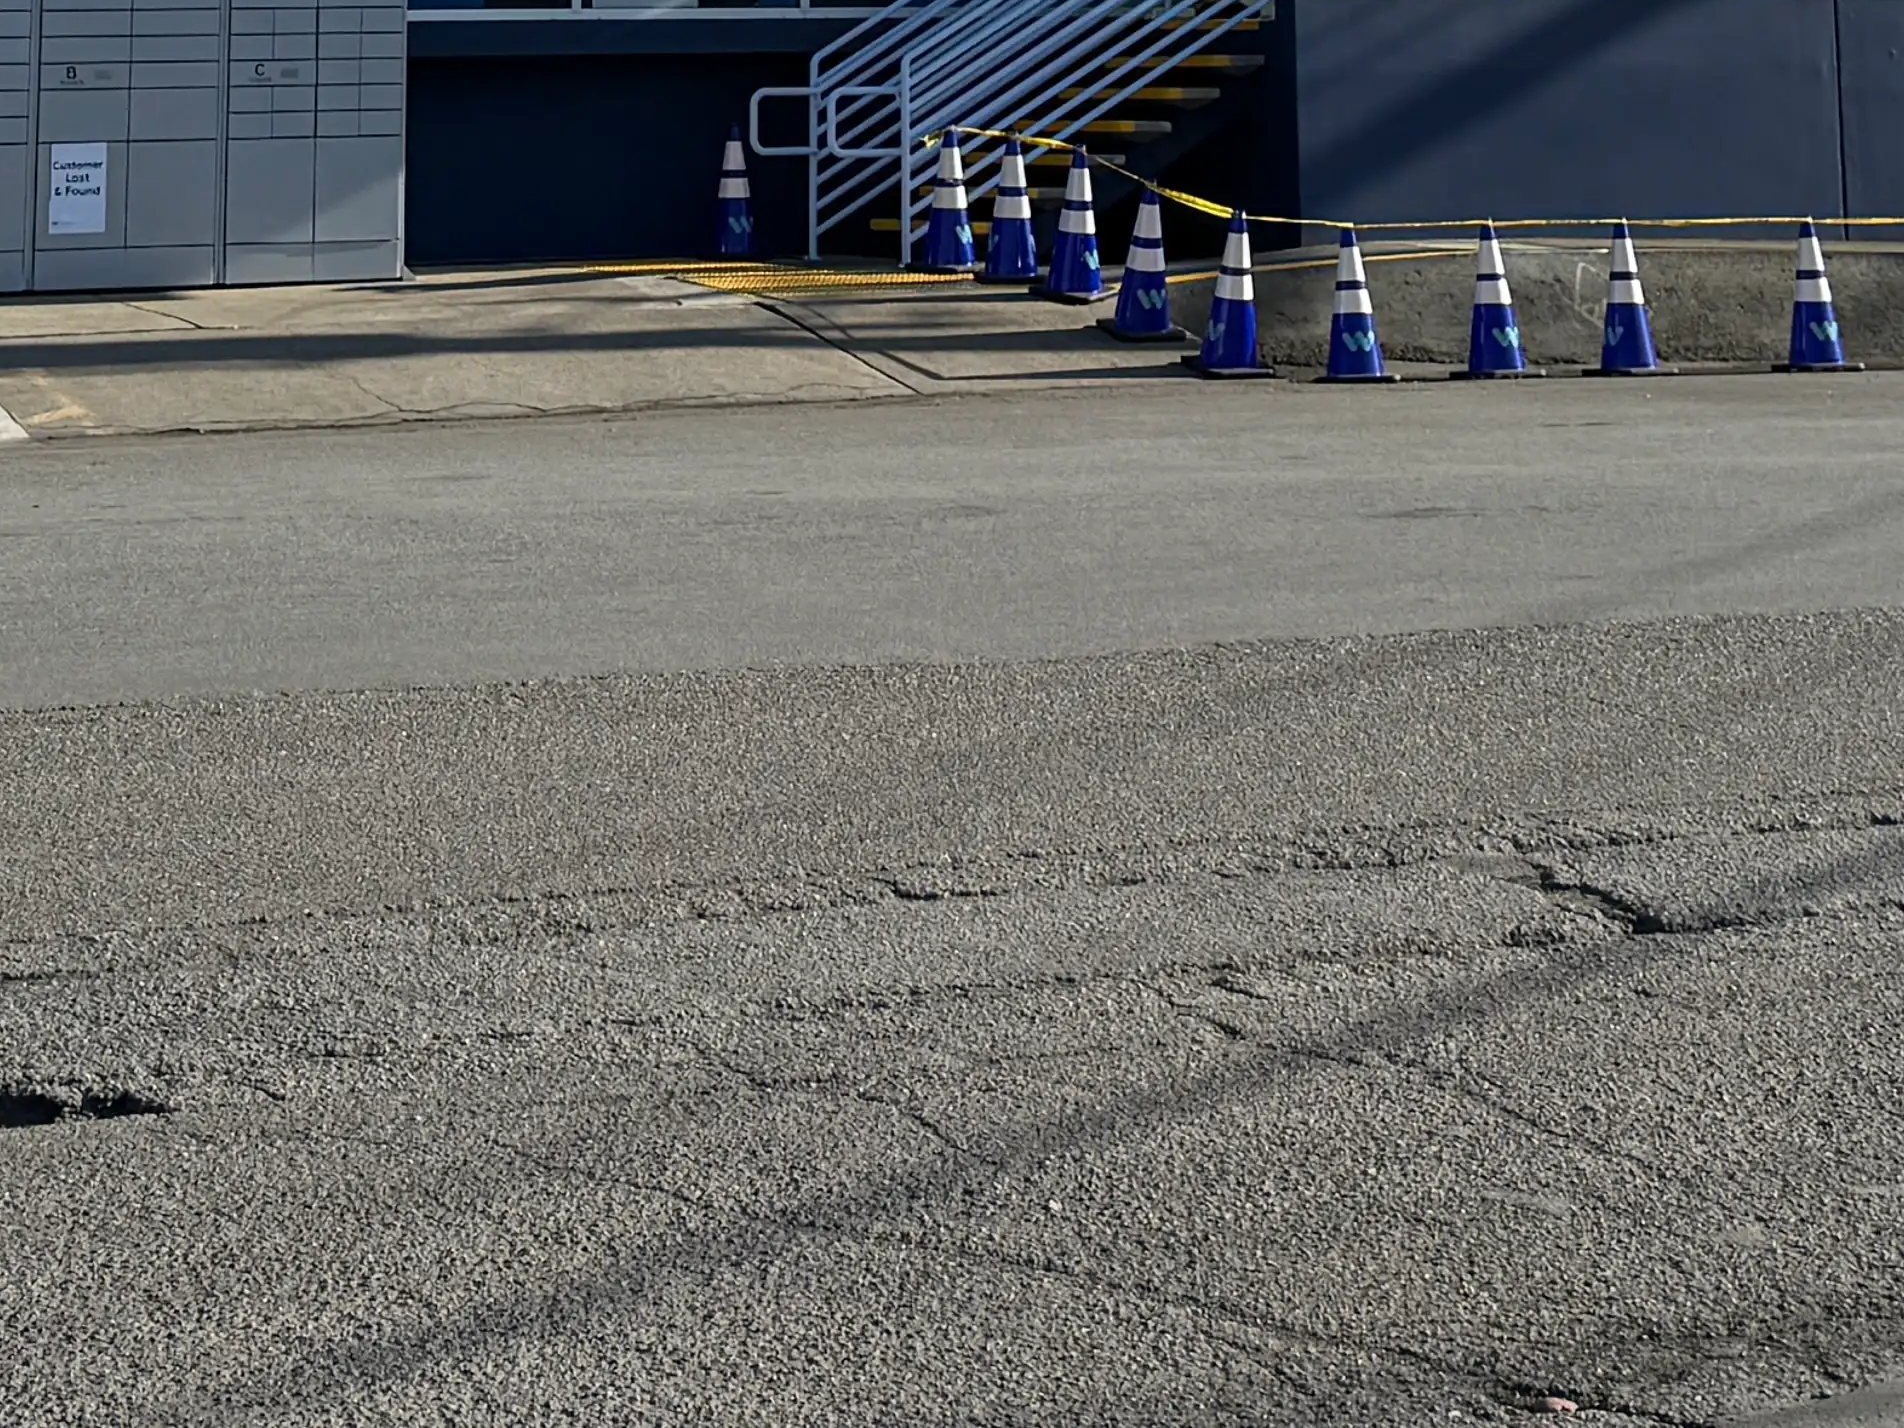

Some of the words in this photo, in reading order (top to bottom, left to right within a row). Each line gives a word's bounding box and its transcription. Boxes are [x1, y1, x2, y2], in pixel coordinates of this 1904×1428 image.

[254, 63, 266, 77] C
[53, 161, 104, 170] Customer
[65, 173, 90, 183] Lost
[65, 185, 101, 196] Found
